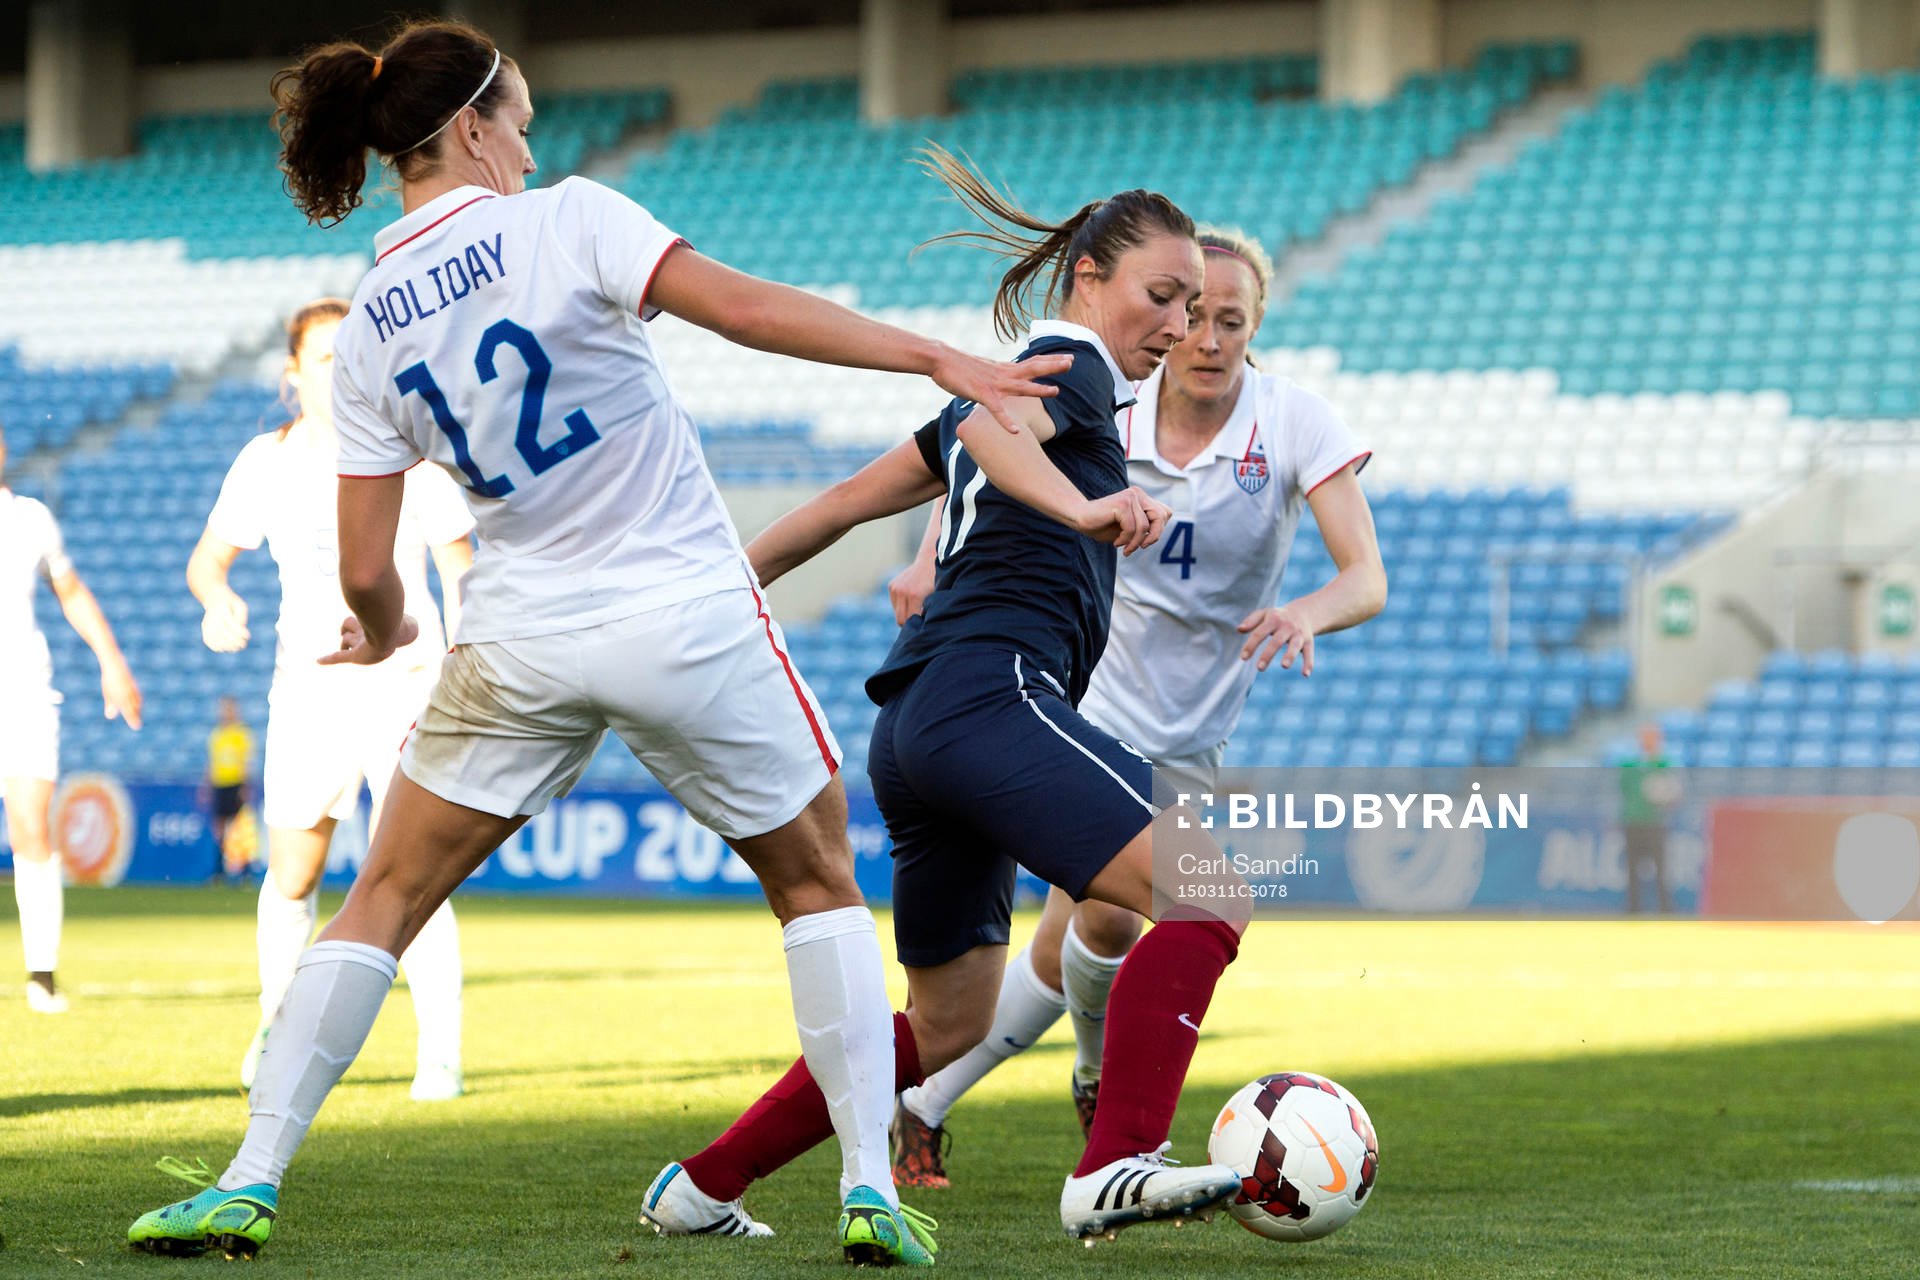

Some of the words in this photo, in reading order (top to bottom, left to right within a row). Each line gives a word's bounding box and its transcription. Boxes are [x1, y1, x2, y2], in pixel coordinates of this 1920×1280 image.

[364, 232, 506, 343] HOLIDAY
[394, 317, 601, 499] 12
[1159, 520, 1197, 580] 4
[500, 799, 629, 881] CUP
